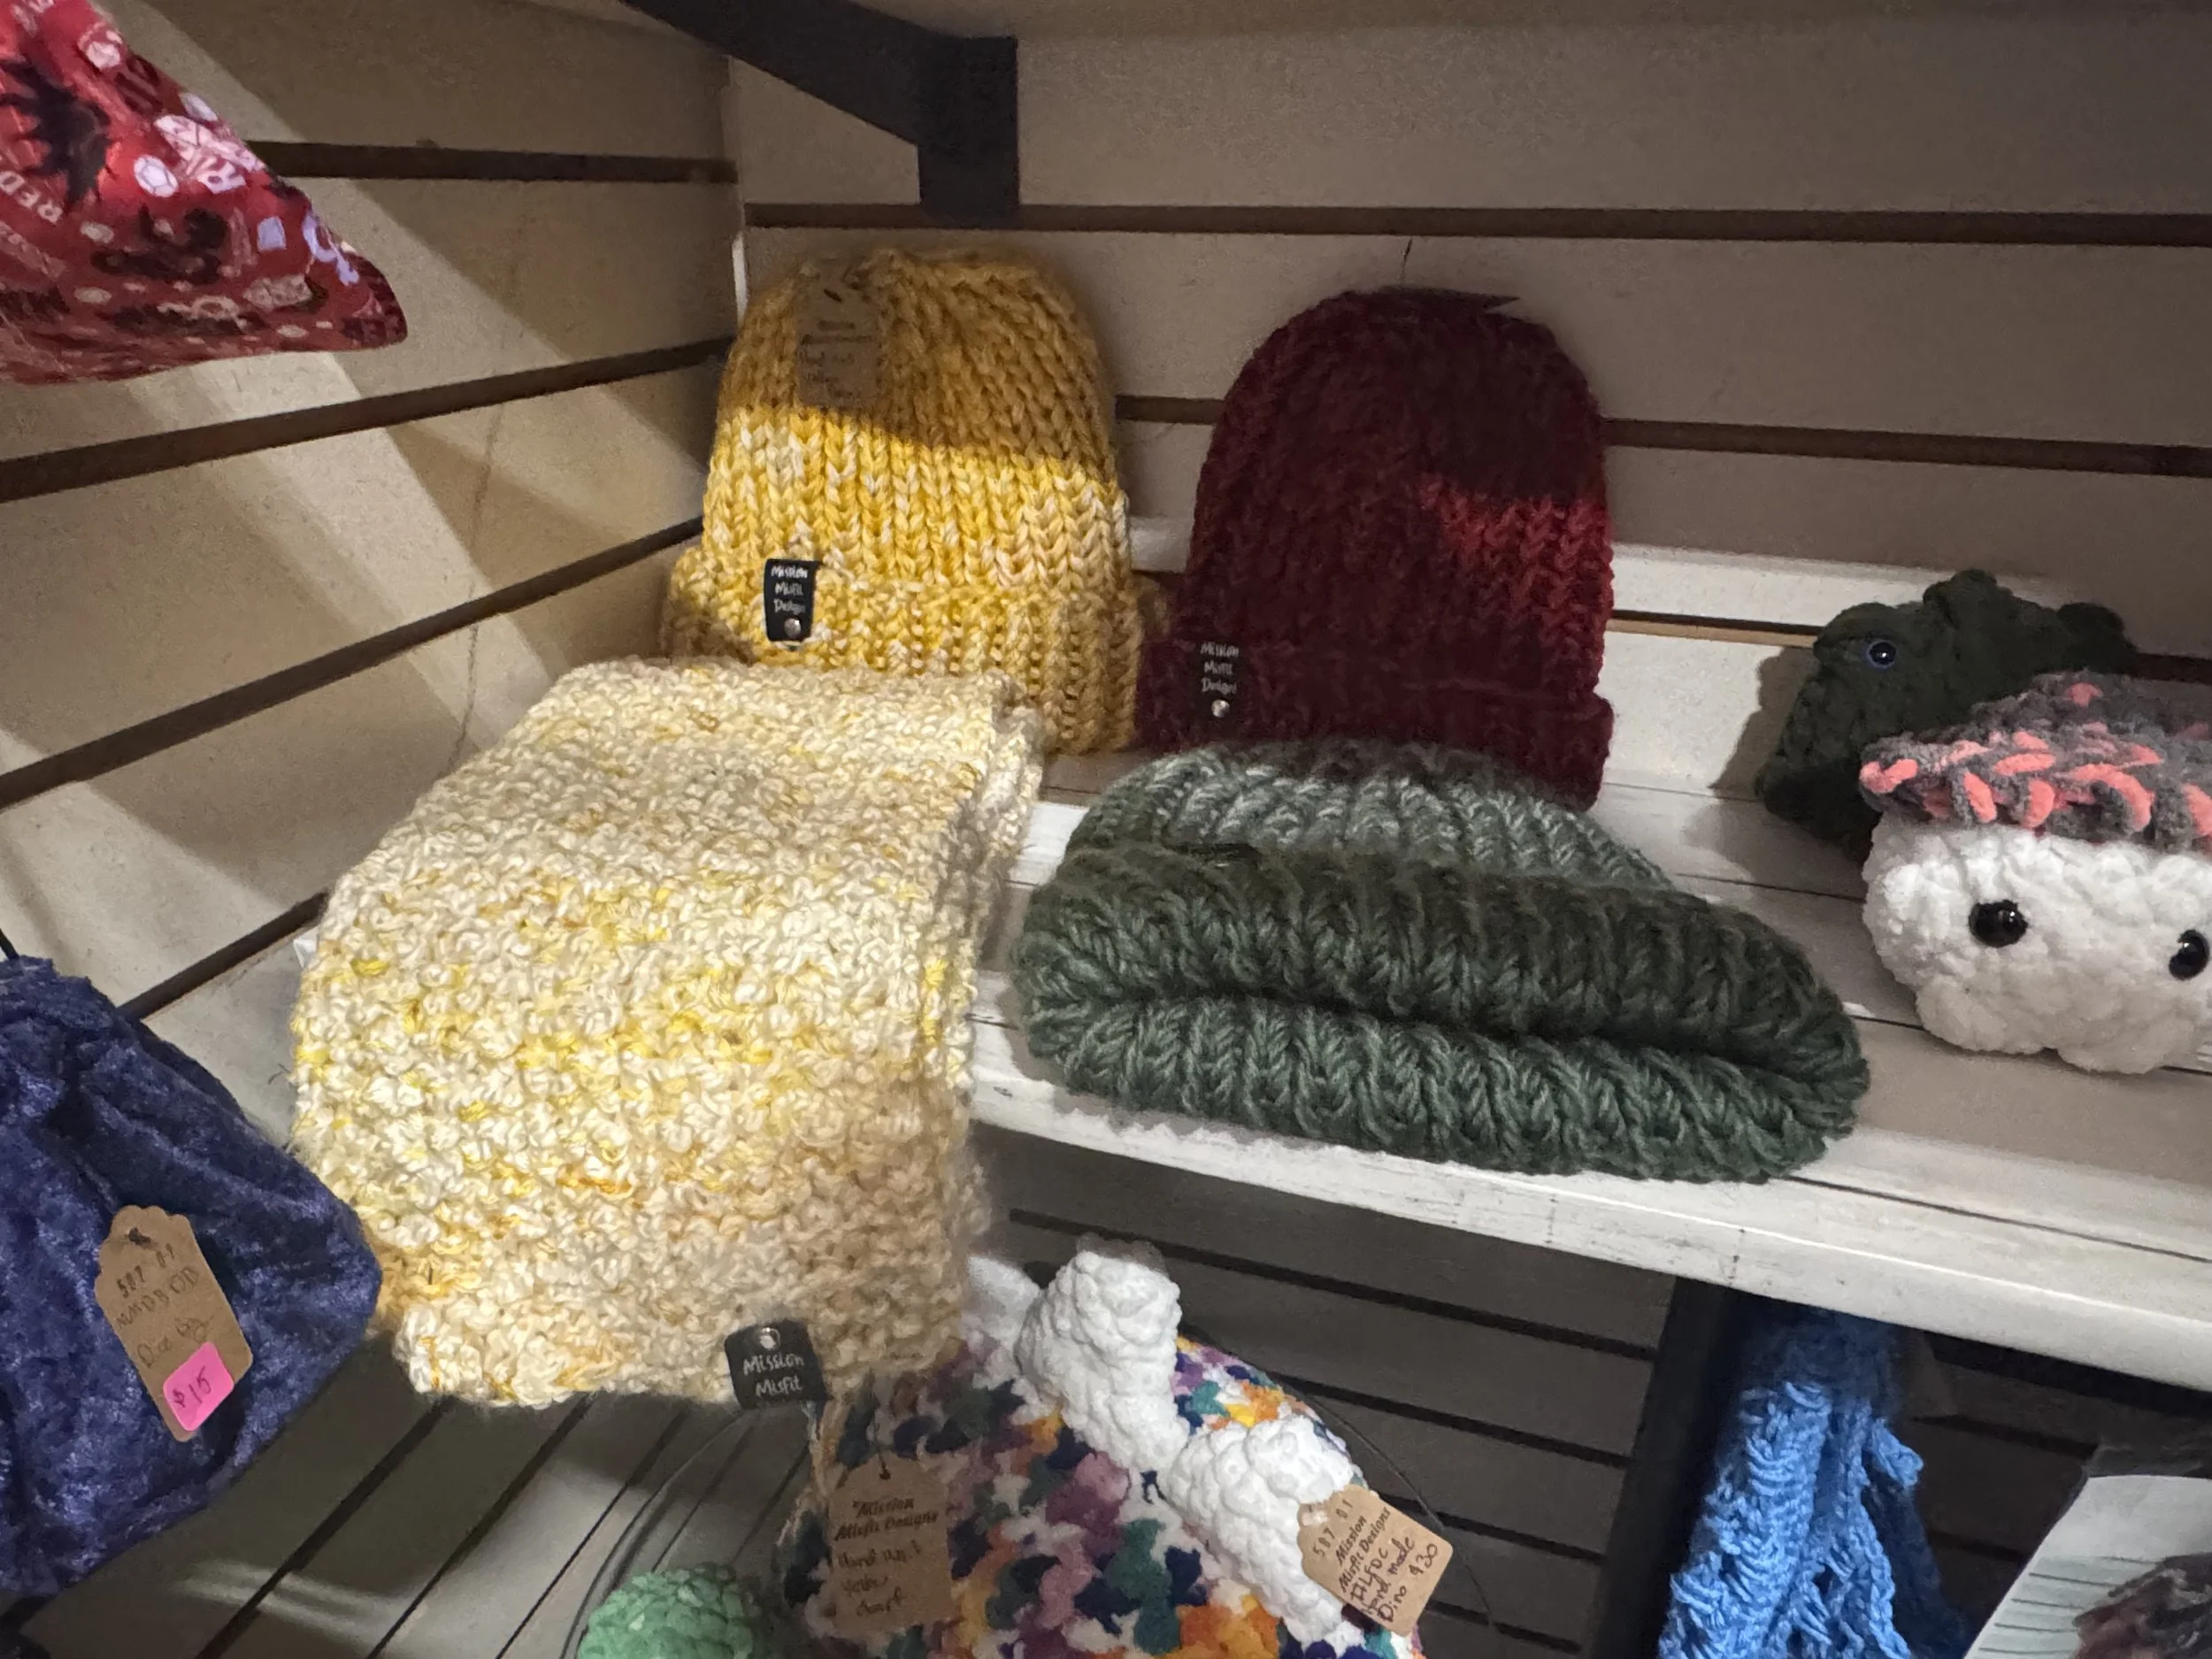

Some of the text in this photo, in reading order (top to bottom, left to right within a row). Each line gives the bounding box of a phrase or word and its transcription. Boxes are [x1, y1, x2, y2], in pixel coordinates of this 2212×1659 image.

[743, 1352, 804, 1376] Mission
[172, 1365, 212, 1409] $15
[755, 1375, 803, 1397] Misfit
[1335, 1515, 1367, 1565] Mission
[1338, 1507, 1391, 1593] Misfit Designs
[1377, 1585, 1408, 1623] Dino
